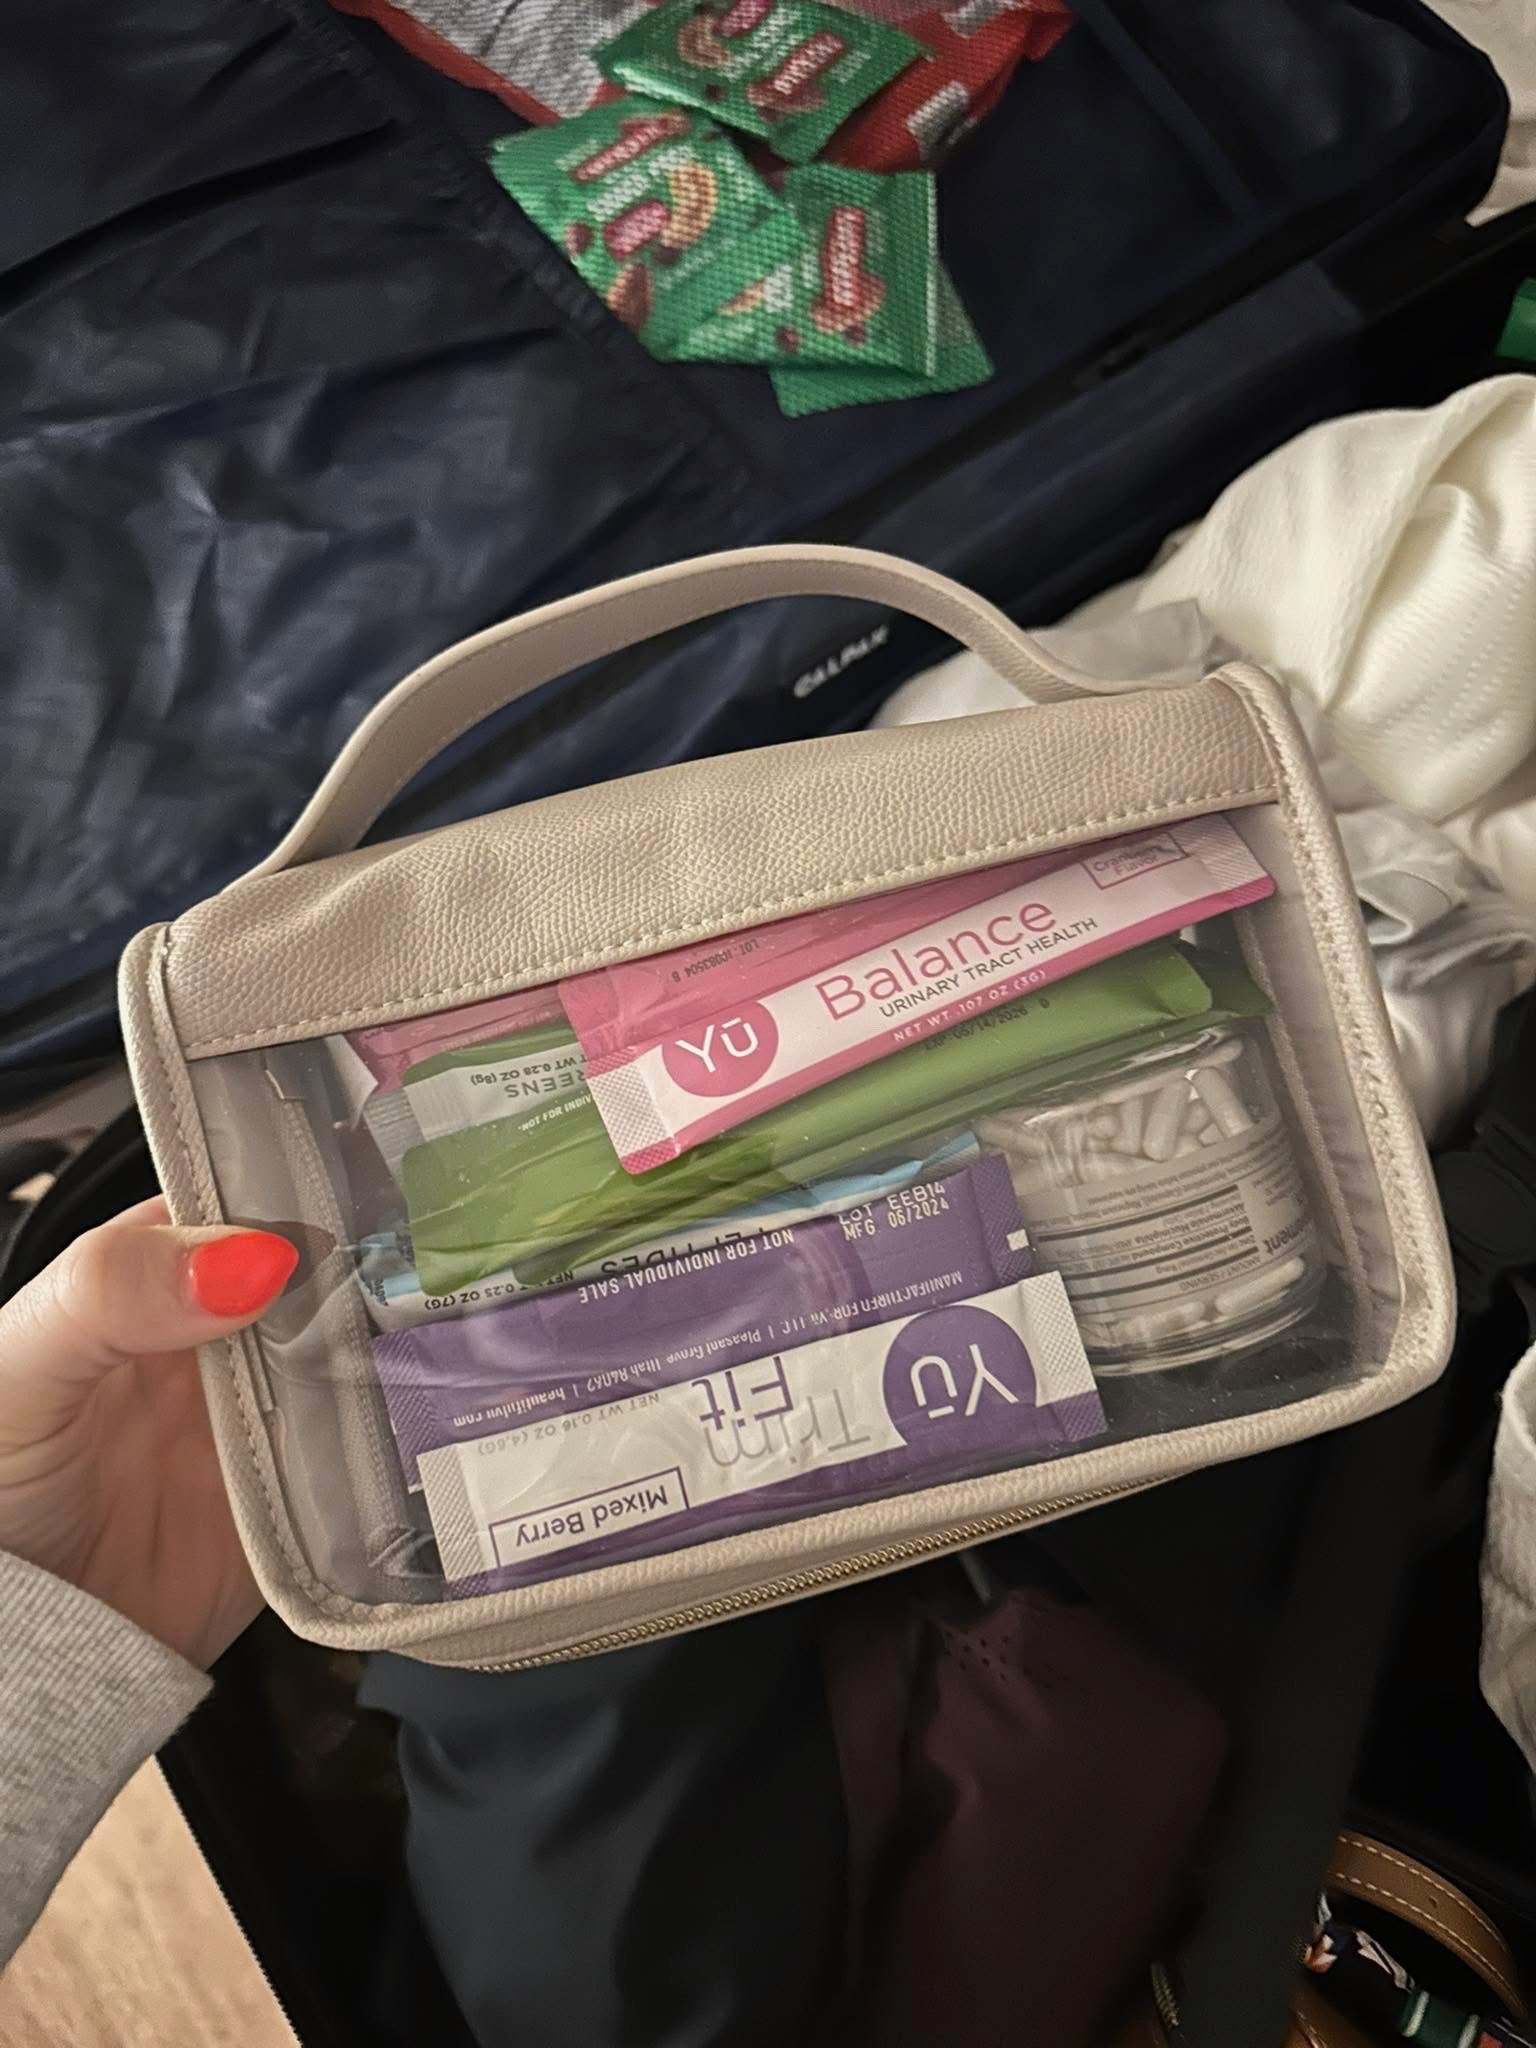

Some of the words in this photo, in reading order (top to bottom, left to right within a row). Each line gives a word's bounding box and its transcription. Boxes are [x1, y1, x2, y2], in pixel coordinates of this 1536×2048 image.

[1114, 854, 1157, 876] Flavor
[816, 903, 1056, 1021] Balance
[880, 974, 961, 1018] URINARY
[964, 947, 1024, 980] TRACT
[1026, 917, 1098, 956] HEALTH
[893, 1023, 921, 1041] NET
[988, 985, 1008, 1000] OZ
[523, 1063, 551, 1076] 0.28
[555, 1057, 576, 1070] WT
[470, 1073, 497, 1086] (8g)
[500, 1070, 520, 1081] OZ
[542, 1105, 563, 1121] FOR
[838, 1203, 872, 1225] LOT
[887, 1182, 945, 1210] EEB14
[843, 1219, 875, 1241] MFG
[888, 1197, 949, 1228] 06/2024
[724, 1240, 757, 1261] FOR
[763, 1229, 794, 1251] NOT
[624, 1250, 721, 1289] INDIVIDUAL
[460, 1291, 480, 1303] OZ
[484, 1283, 515, 1297] 0.25
[577, 1278, 620, 1304] SALE
[861, 1271, 963, 1312] MANUFACTURED
[425, 1295, 456, 1310] (7G)
[706, 1329, 761, 1353] Pleasant
[631, 1358, 661, 1377] Utah
[630, 1393, 660, 1411] NET
[691, 1356, 795, 1431] Fit
[562, 1413, 592, 1432] 0.16
[598, 1405, 624, 1419] WT
[535, 1427, 556, 1440] OZ
[702, 1389, 871, 1467] Trim
[595, 1485, 668, 1528] Mixed
[515, 1511, 584, 1547] Berry
